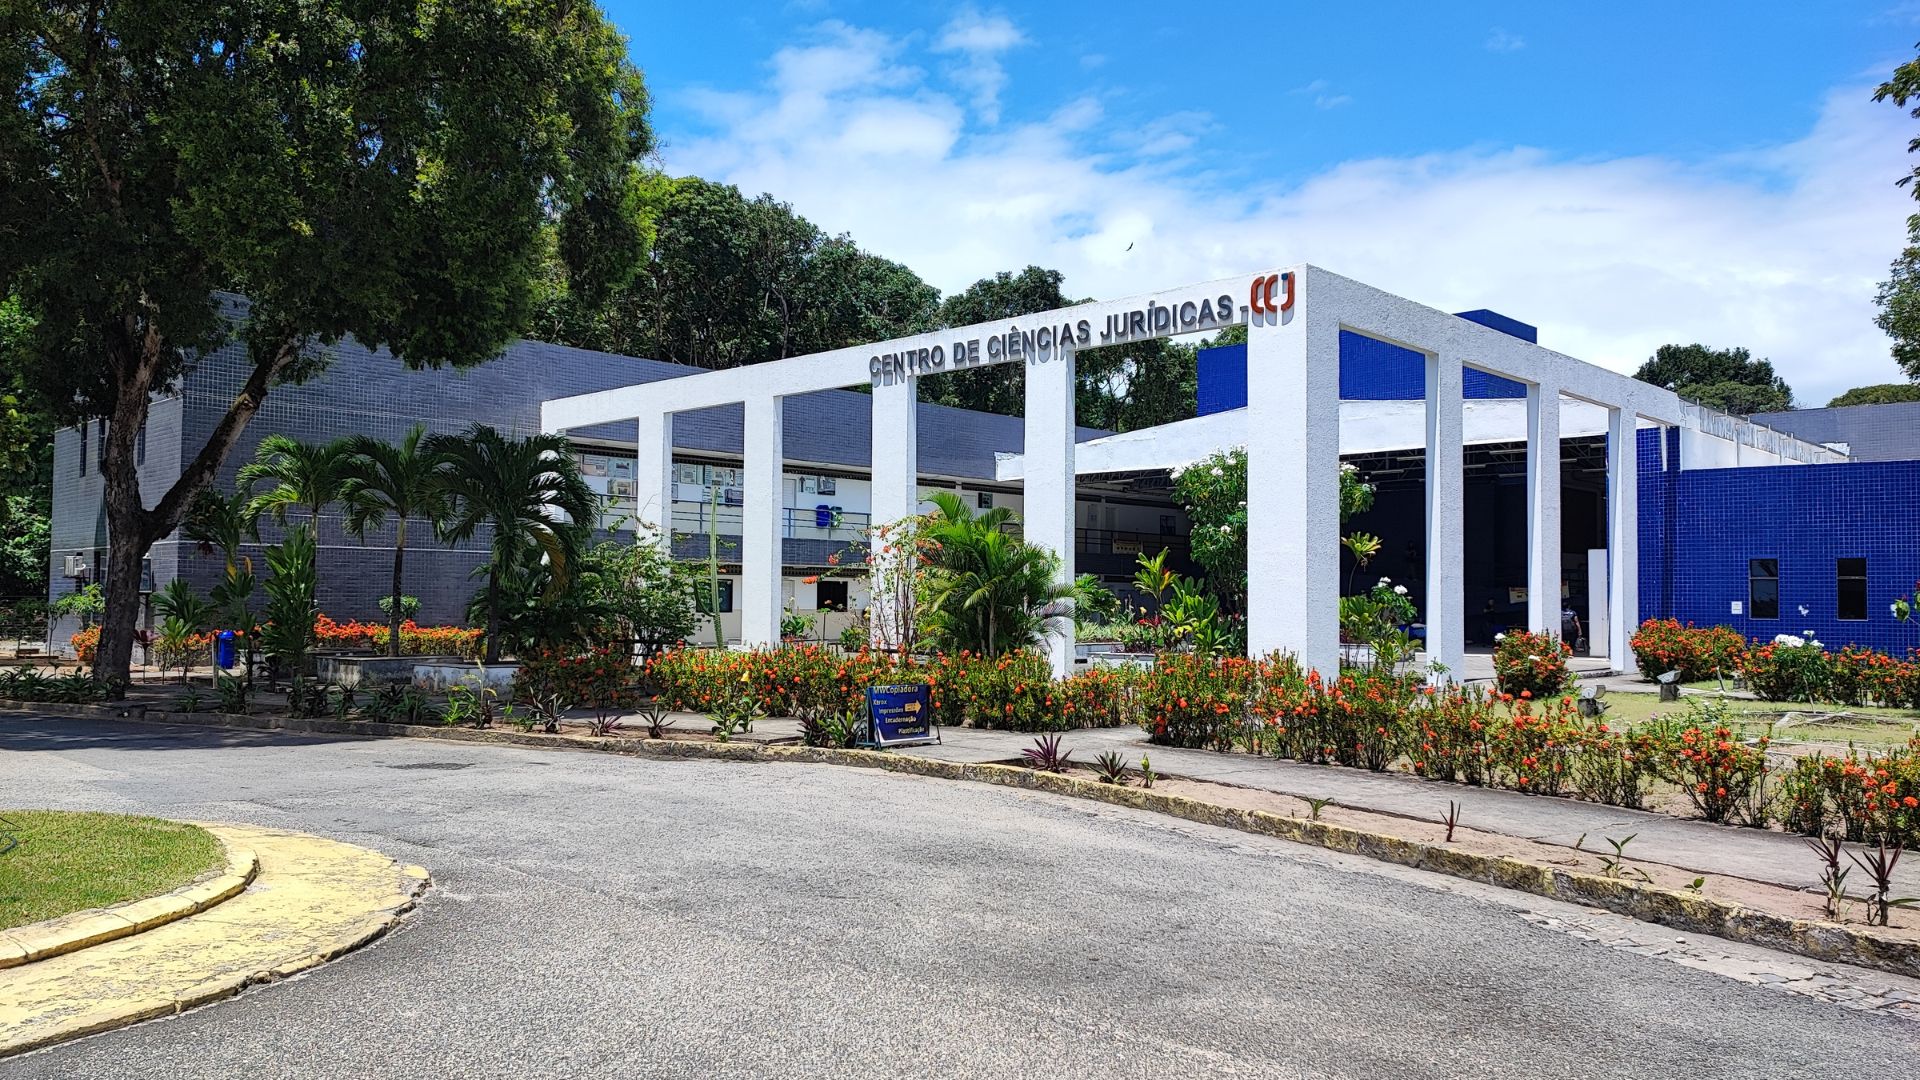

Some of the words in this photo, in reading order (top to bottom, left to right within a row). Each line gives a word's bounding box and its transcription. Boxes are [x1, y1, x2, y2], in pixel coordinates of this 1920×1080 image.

[869, 345, 945, 377] CENTRO
[953, 339, 980, 364] DE
[987, 319, 1091, 358] CIÊNCIAS
[1100, 294, 1234, 338] JURÍDICAS
[1251, 271, 1296, 315] CCJ
